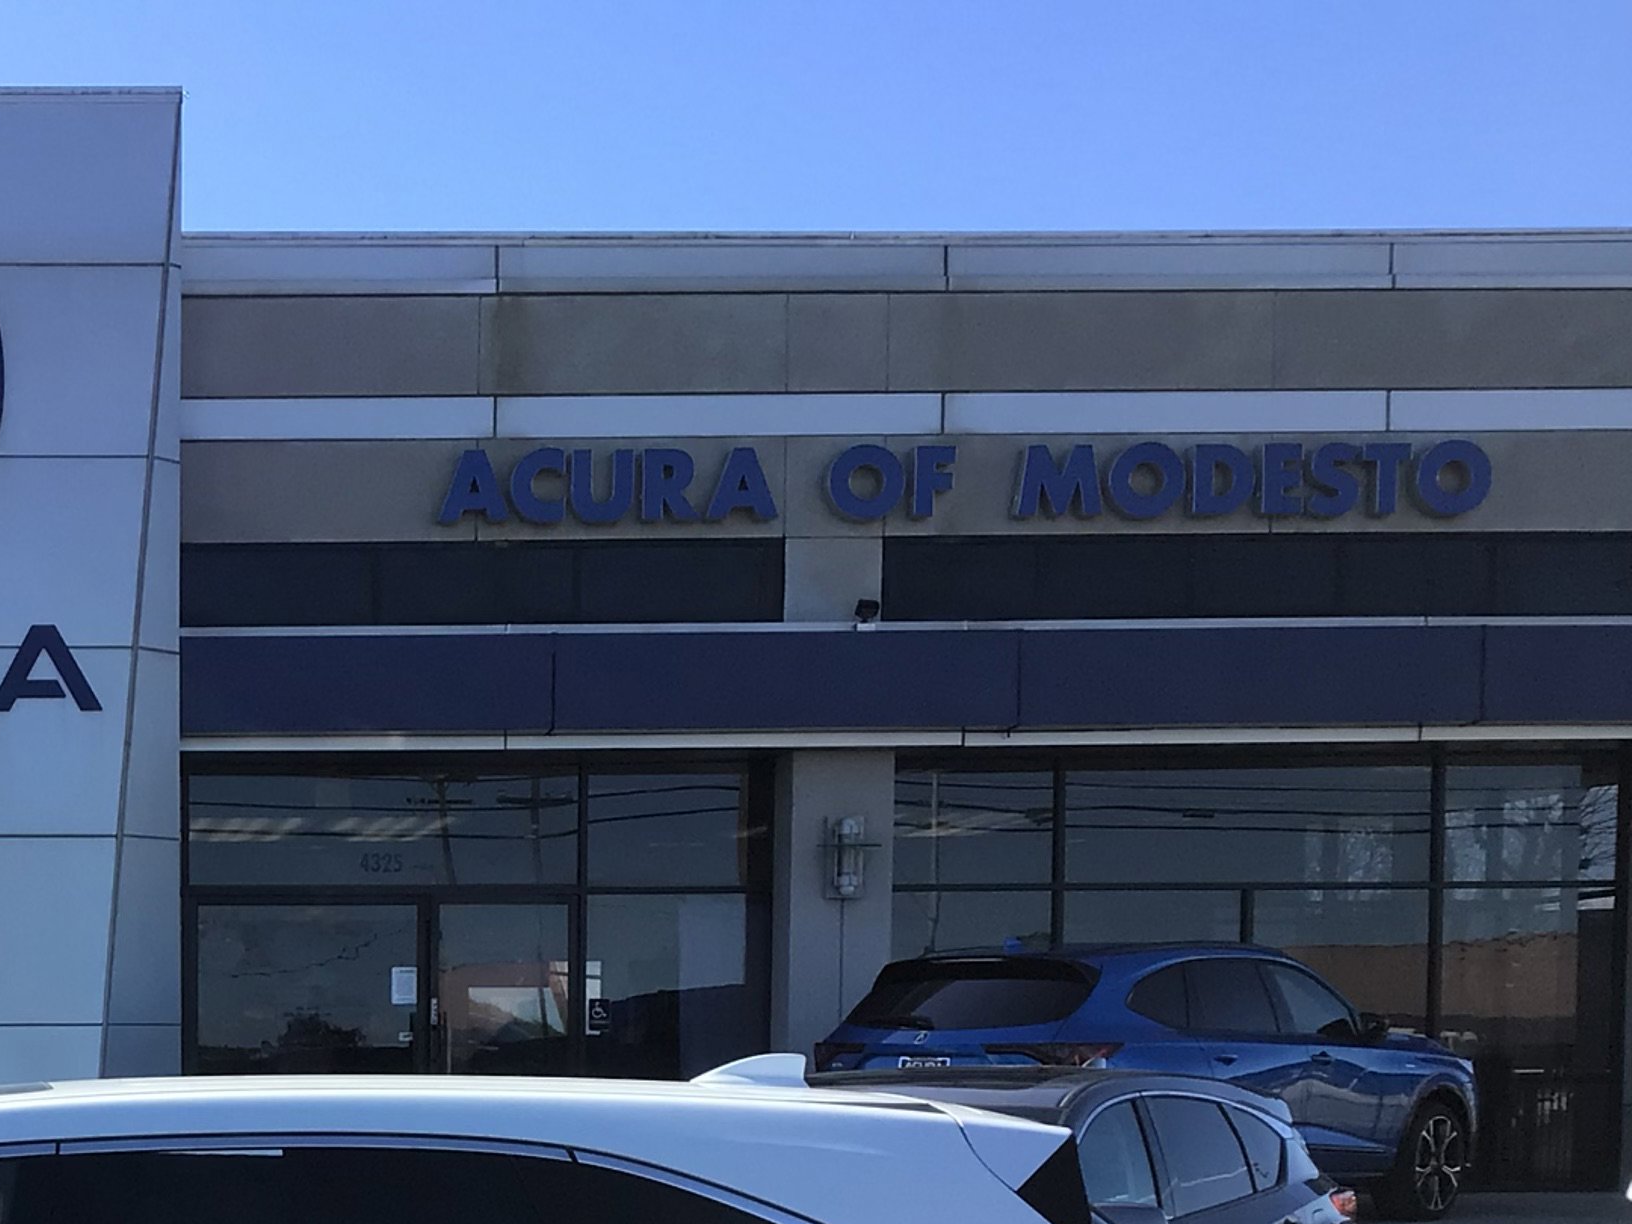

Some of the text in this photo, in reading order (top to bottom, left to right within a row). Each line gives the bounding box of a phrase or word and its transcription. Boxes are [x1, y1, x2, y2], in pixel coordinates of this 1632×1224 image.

[437, 439, 1493, 524] ACURA OF MODESTO
[359, 852, 404, 874] 4325
